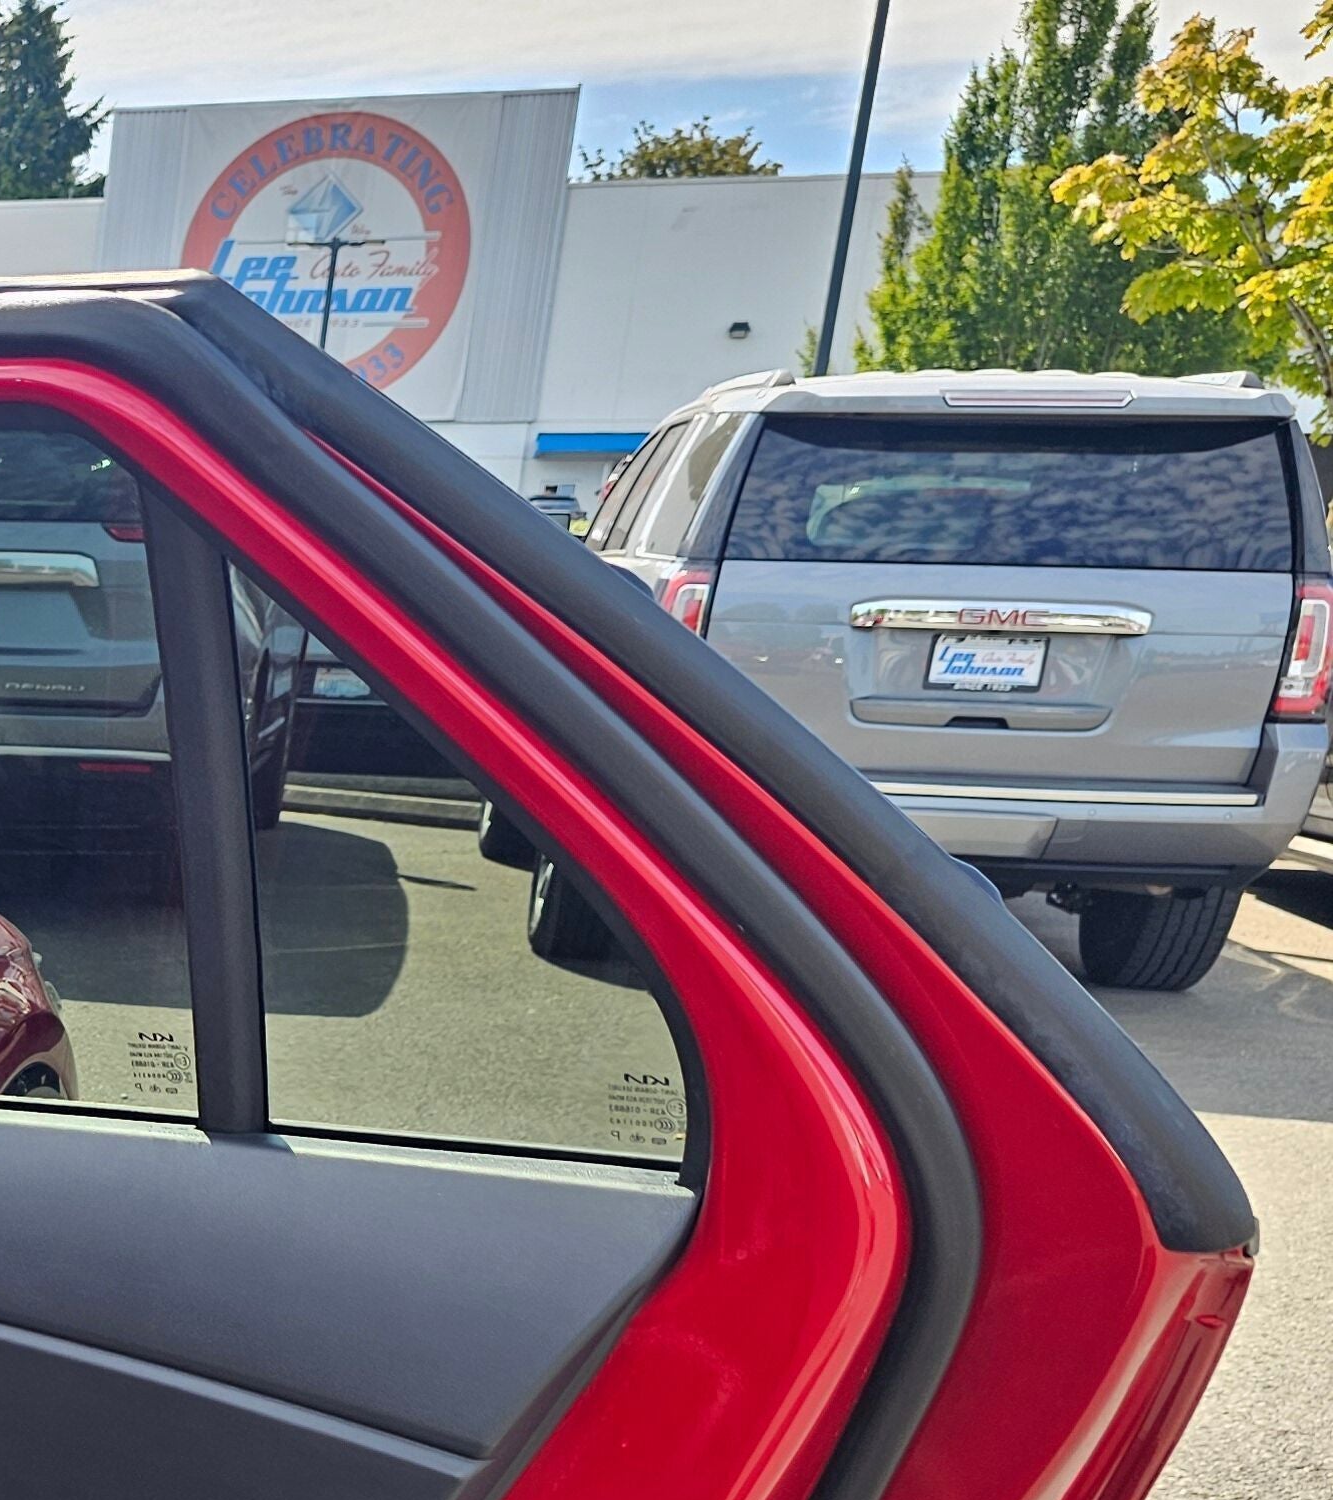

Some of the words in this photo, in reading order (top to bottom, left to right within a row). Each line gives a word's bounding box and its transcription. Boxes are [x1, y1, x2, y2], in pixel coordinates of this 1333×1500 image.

[209, 122, 455, 221] CELEBRATING
[211, 239, 299, 279] Lee
[367, 249, 438, 281] Family
[958, 608, 1049, 627] GMC
[938, 645, 976, 662] Lee
[938, 659, 1025, 676] Johnson
